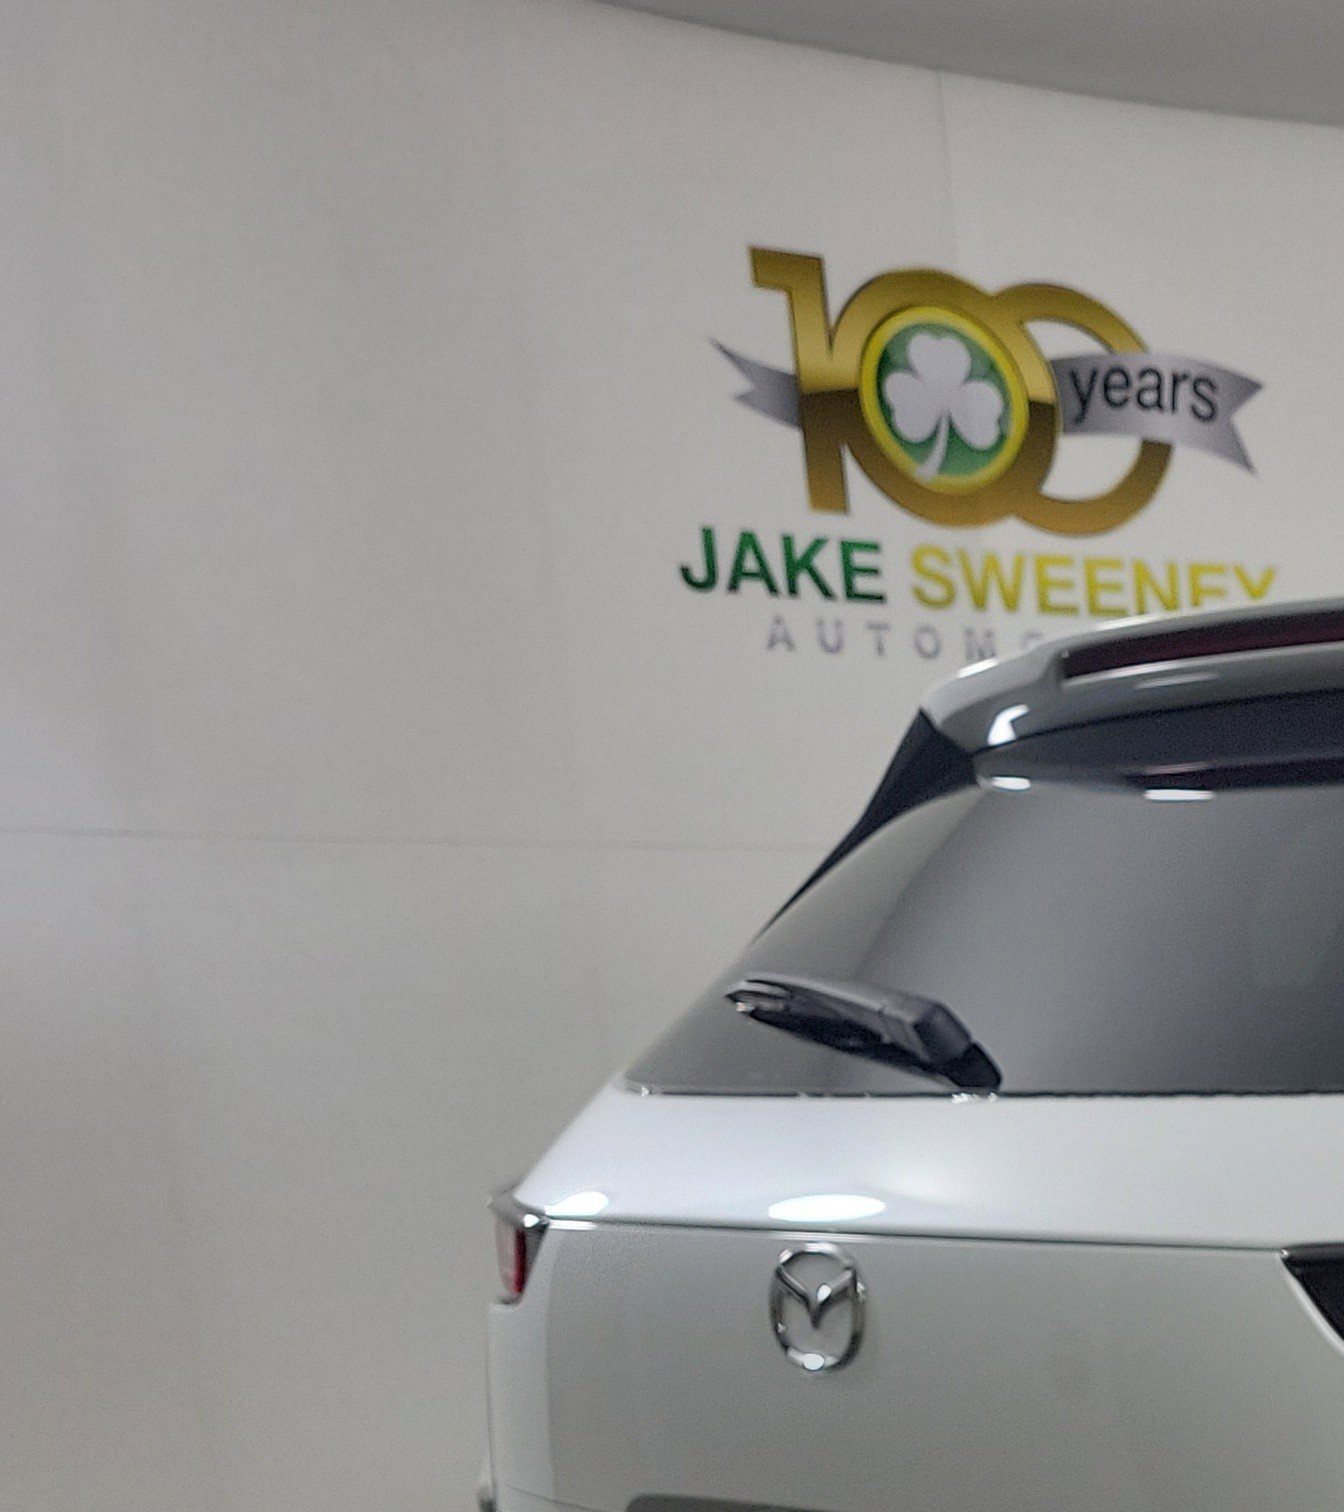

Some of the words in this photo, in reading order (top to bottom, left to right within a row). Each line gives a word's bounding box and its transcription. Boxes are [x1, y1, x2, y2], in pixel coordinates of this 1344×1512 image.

[1067, 362, 1219, 424] years
[679, 526, 887, 605] JAKE
[909, 543, 1277, 616] SWEENEY
